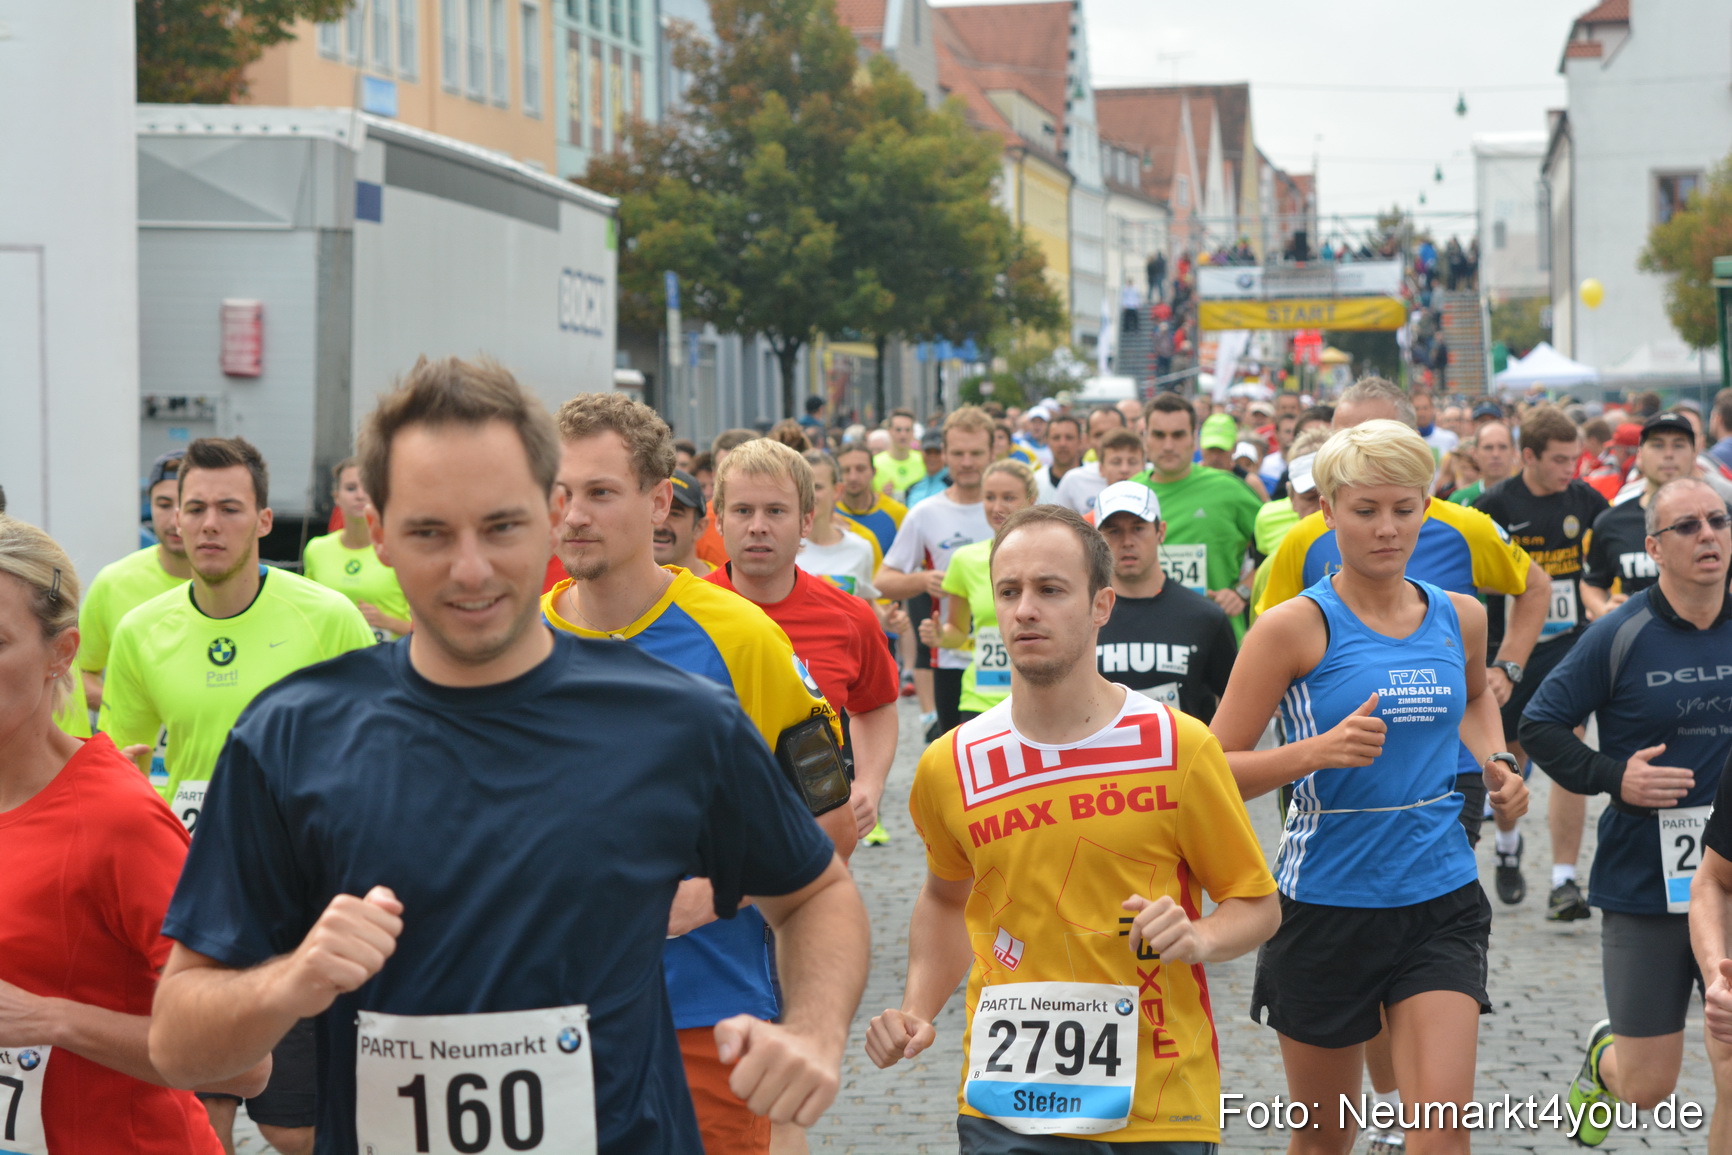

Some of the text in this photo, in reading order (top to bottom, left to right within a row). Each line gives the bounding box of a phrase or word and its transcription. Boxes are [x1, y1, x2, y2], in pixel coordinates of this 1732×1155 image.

[1266, 305, 1336, 323] START
[1378, 686, 1452, 697] RAMSAUER
[1397, 697, 1434, 705] ZIMMEREI
[1382, 706, 1448, 716] DACHEINDECKUNG
[1392, 714, 1435, 724] GERÜSTBAU
[1677, 725, 1717, 737] Running
[967, 799, 1058, 848] MAX
[1068, 782, 1178, 820] BÖGL
[1662, 818, 1702, 829] PARTL
[979, 997, 1027, 1013] PARTL
[1030, 997, 1109, 1013] Neumarkt
[360, 1035, 548, 1060] PARTL Neumarkt
[985, 1019, 1122, 1077] 2794
[1013, 1089, 1082, 1113] Stefan
[397, 1069, 544, 1154] 160
